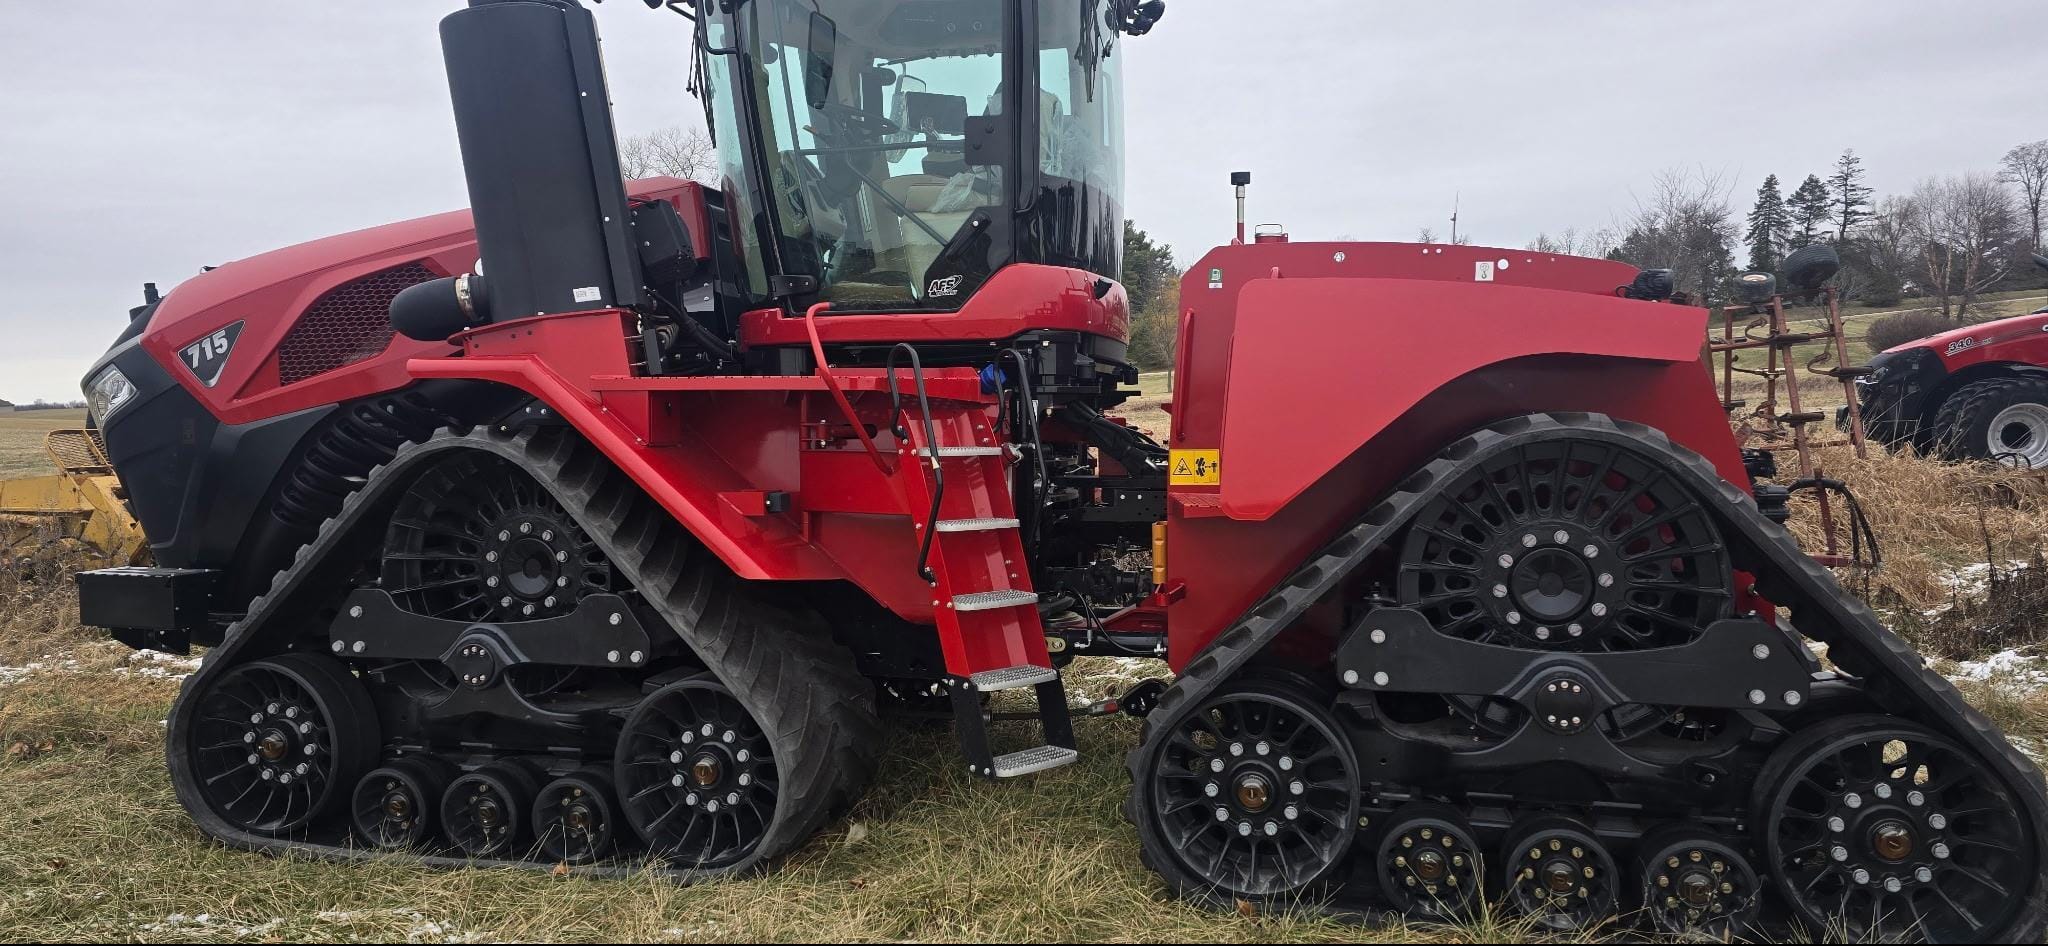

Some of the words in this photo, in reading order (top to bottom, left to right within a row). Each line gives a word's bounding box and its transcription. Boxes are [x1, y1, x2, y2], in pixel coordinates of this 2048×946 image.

[928, 277, 956, 293] AFS
[187, 329, 228, 369] 715
[1948, 336, 1973, 352] 340
